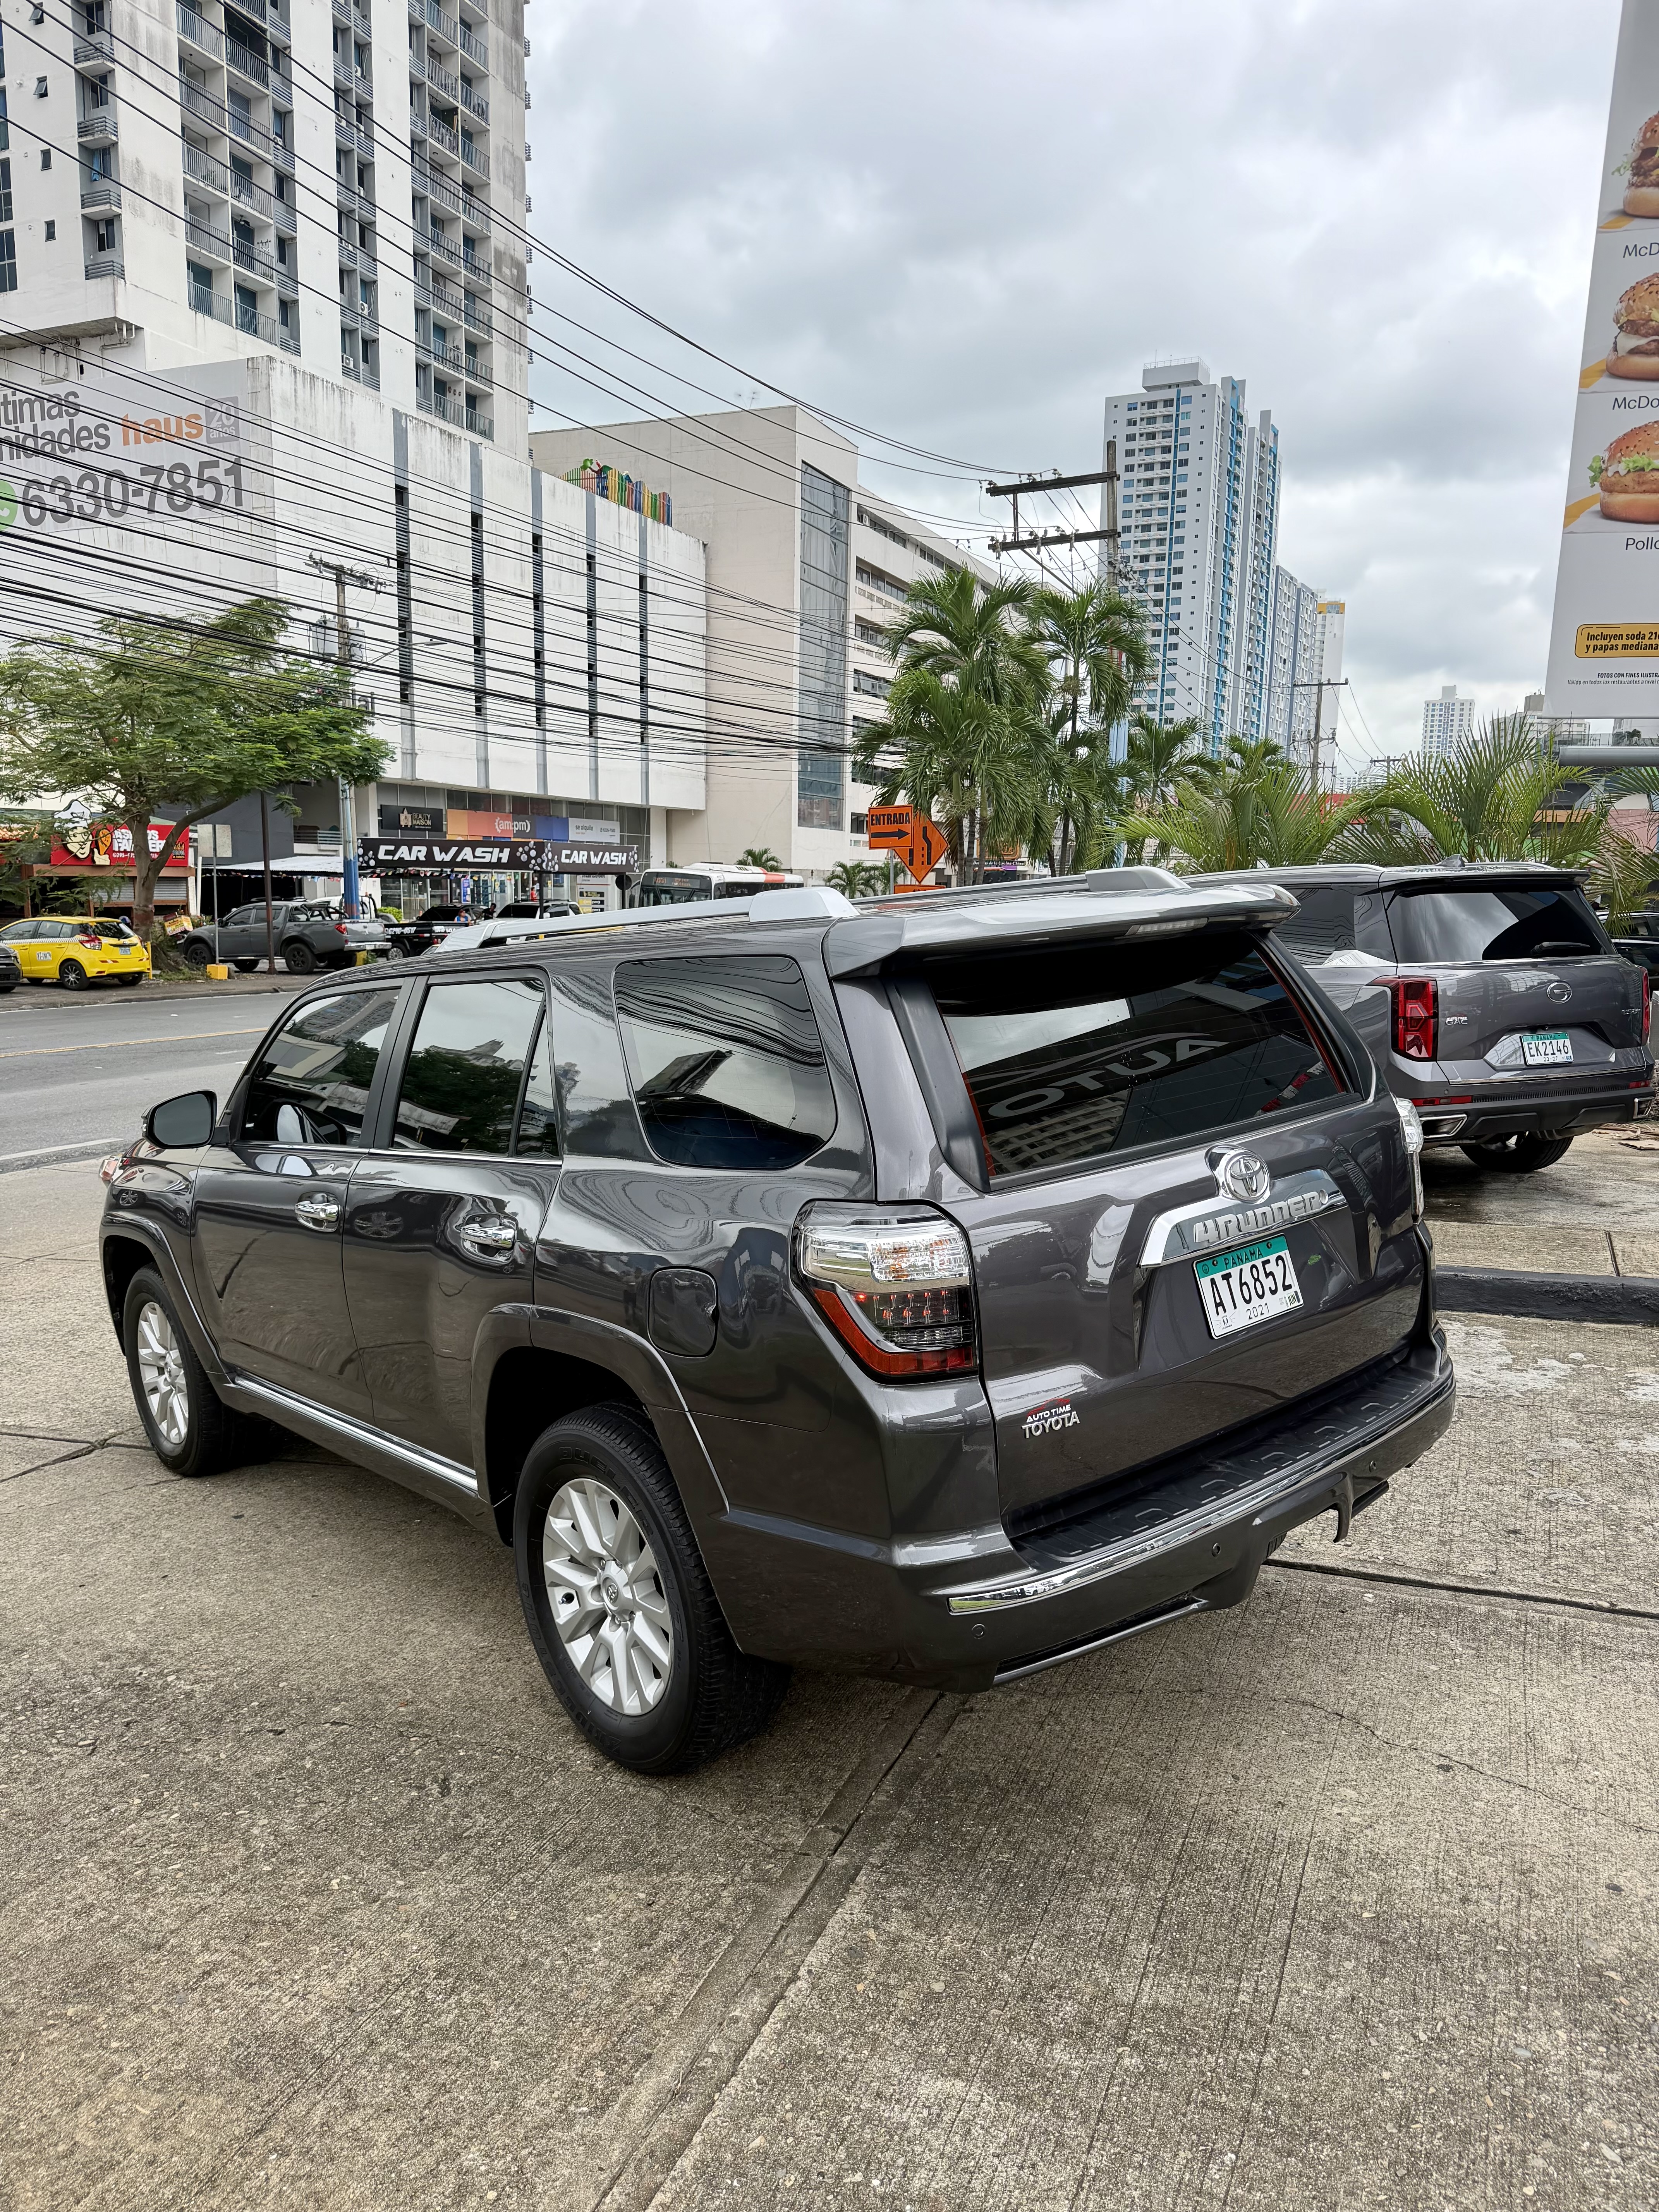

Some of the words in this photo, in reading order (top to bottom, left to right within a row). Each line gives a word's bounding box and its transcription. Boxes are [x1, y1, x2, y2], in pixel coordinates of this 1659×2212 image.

[210, 401, 235, 427] 20
[122, 413, 203, 446] haus
[210, 424, 235, 438] años
[22, 458, 243, 526] 6330-7851
[1587, 632, 1623, 643] Incluyen
[1625, 631, 1646, 640] soda
[1648, 631, 1659, 640] 21
[1585, 644, 1591, 654] y
[1592, 644, 1619, 653] papas
[871, 812, 910, 826] ENTRADA
[378, 845, 427, 861] CAR
[433, 846, 510, 863] WASH
[561, 850, 588, 864] CAR
[590, 851, 627, 865] WASH
[1527, 1040, 1569, 1057] EK2146
[1224, 1247, 1263, 1270] PANAMA
[1210, 1255, 1293, 1316] AT6852
[1288, 1293, 1297, 1306] JUN
[1246, 1302, 1270, 1320] 2021
[1026, 1411, 1050, 1423] AUTO
[1051, 1404, 1071, 1416] TIME
[1021, 1411, 1080, 1438] TOYOTA
